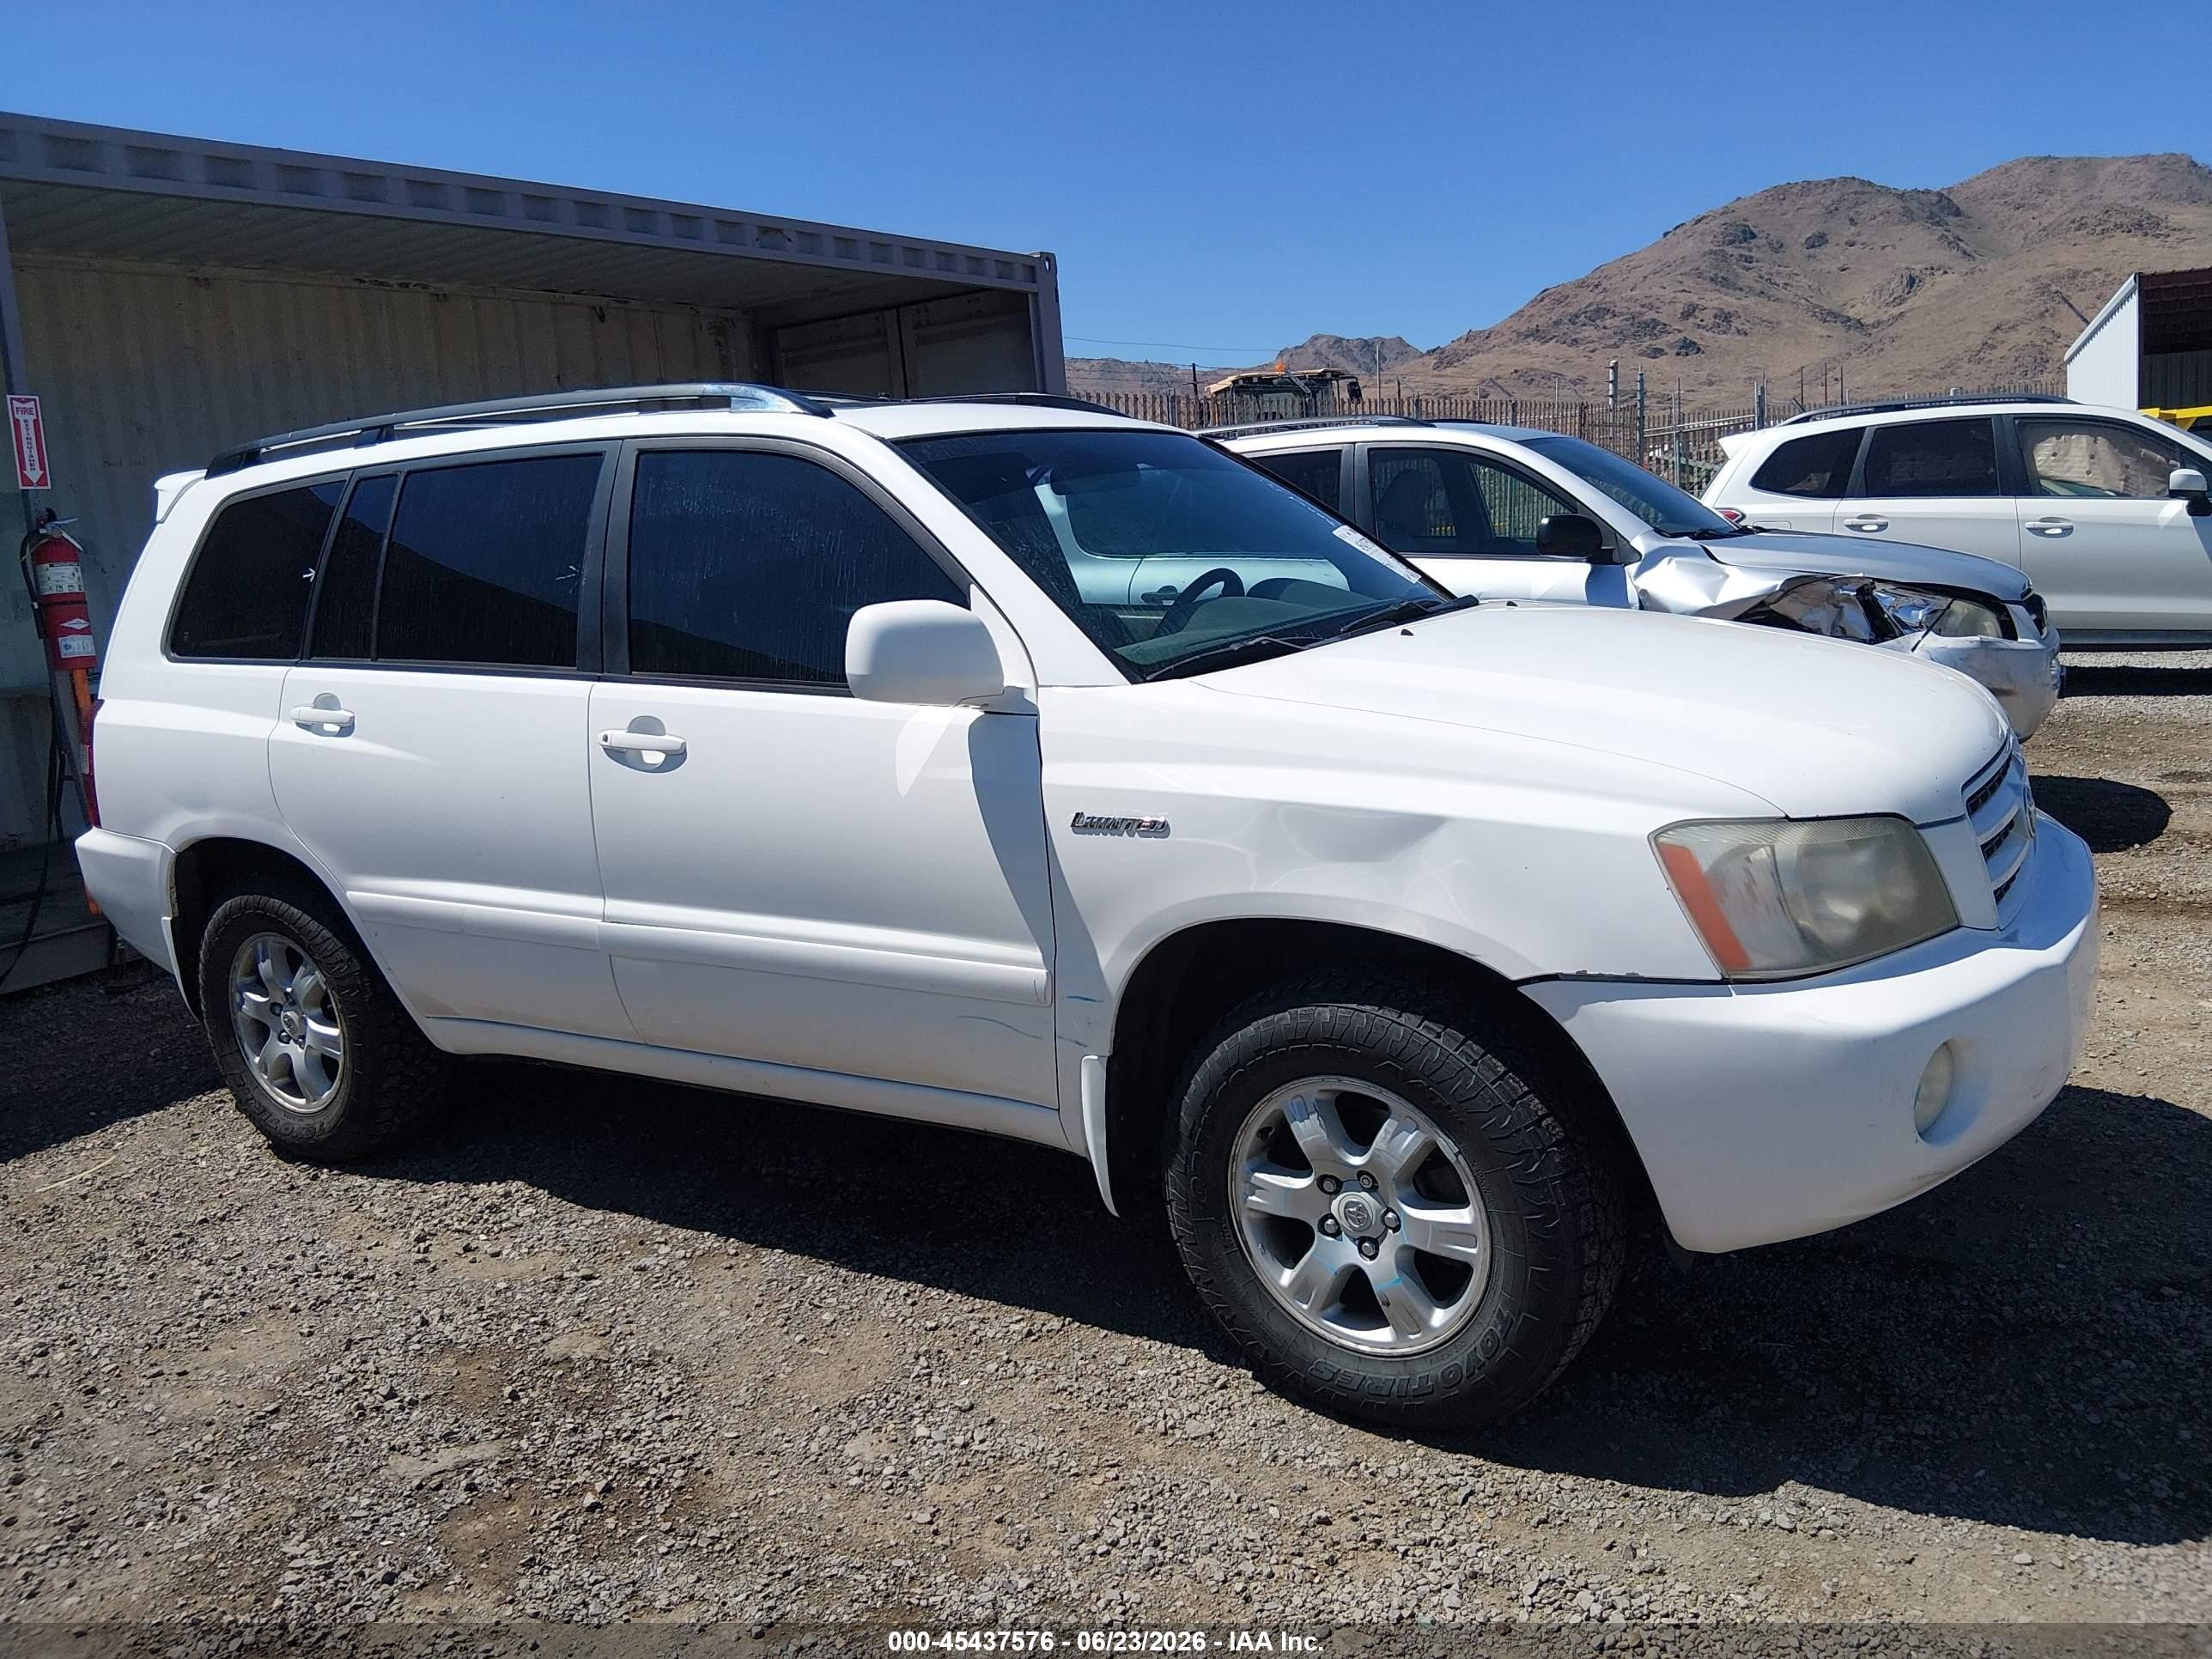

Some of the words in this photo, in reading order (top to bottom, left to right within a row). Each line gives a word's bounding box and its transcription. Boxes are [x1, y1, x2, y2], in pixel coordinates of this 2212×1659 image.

[15, 407, 34, 416] FIRE
[24, 419, 36, 471] EXTINGUISHER
[1438, 1304, 1515, 1389] TOYO
[1305, 1358, 1435, 1399] TIRES
